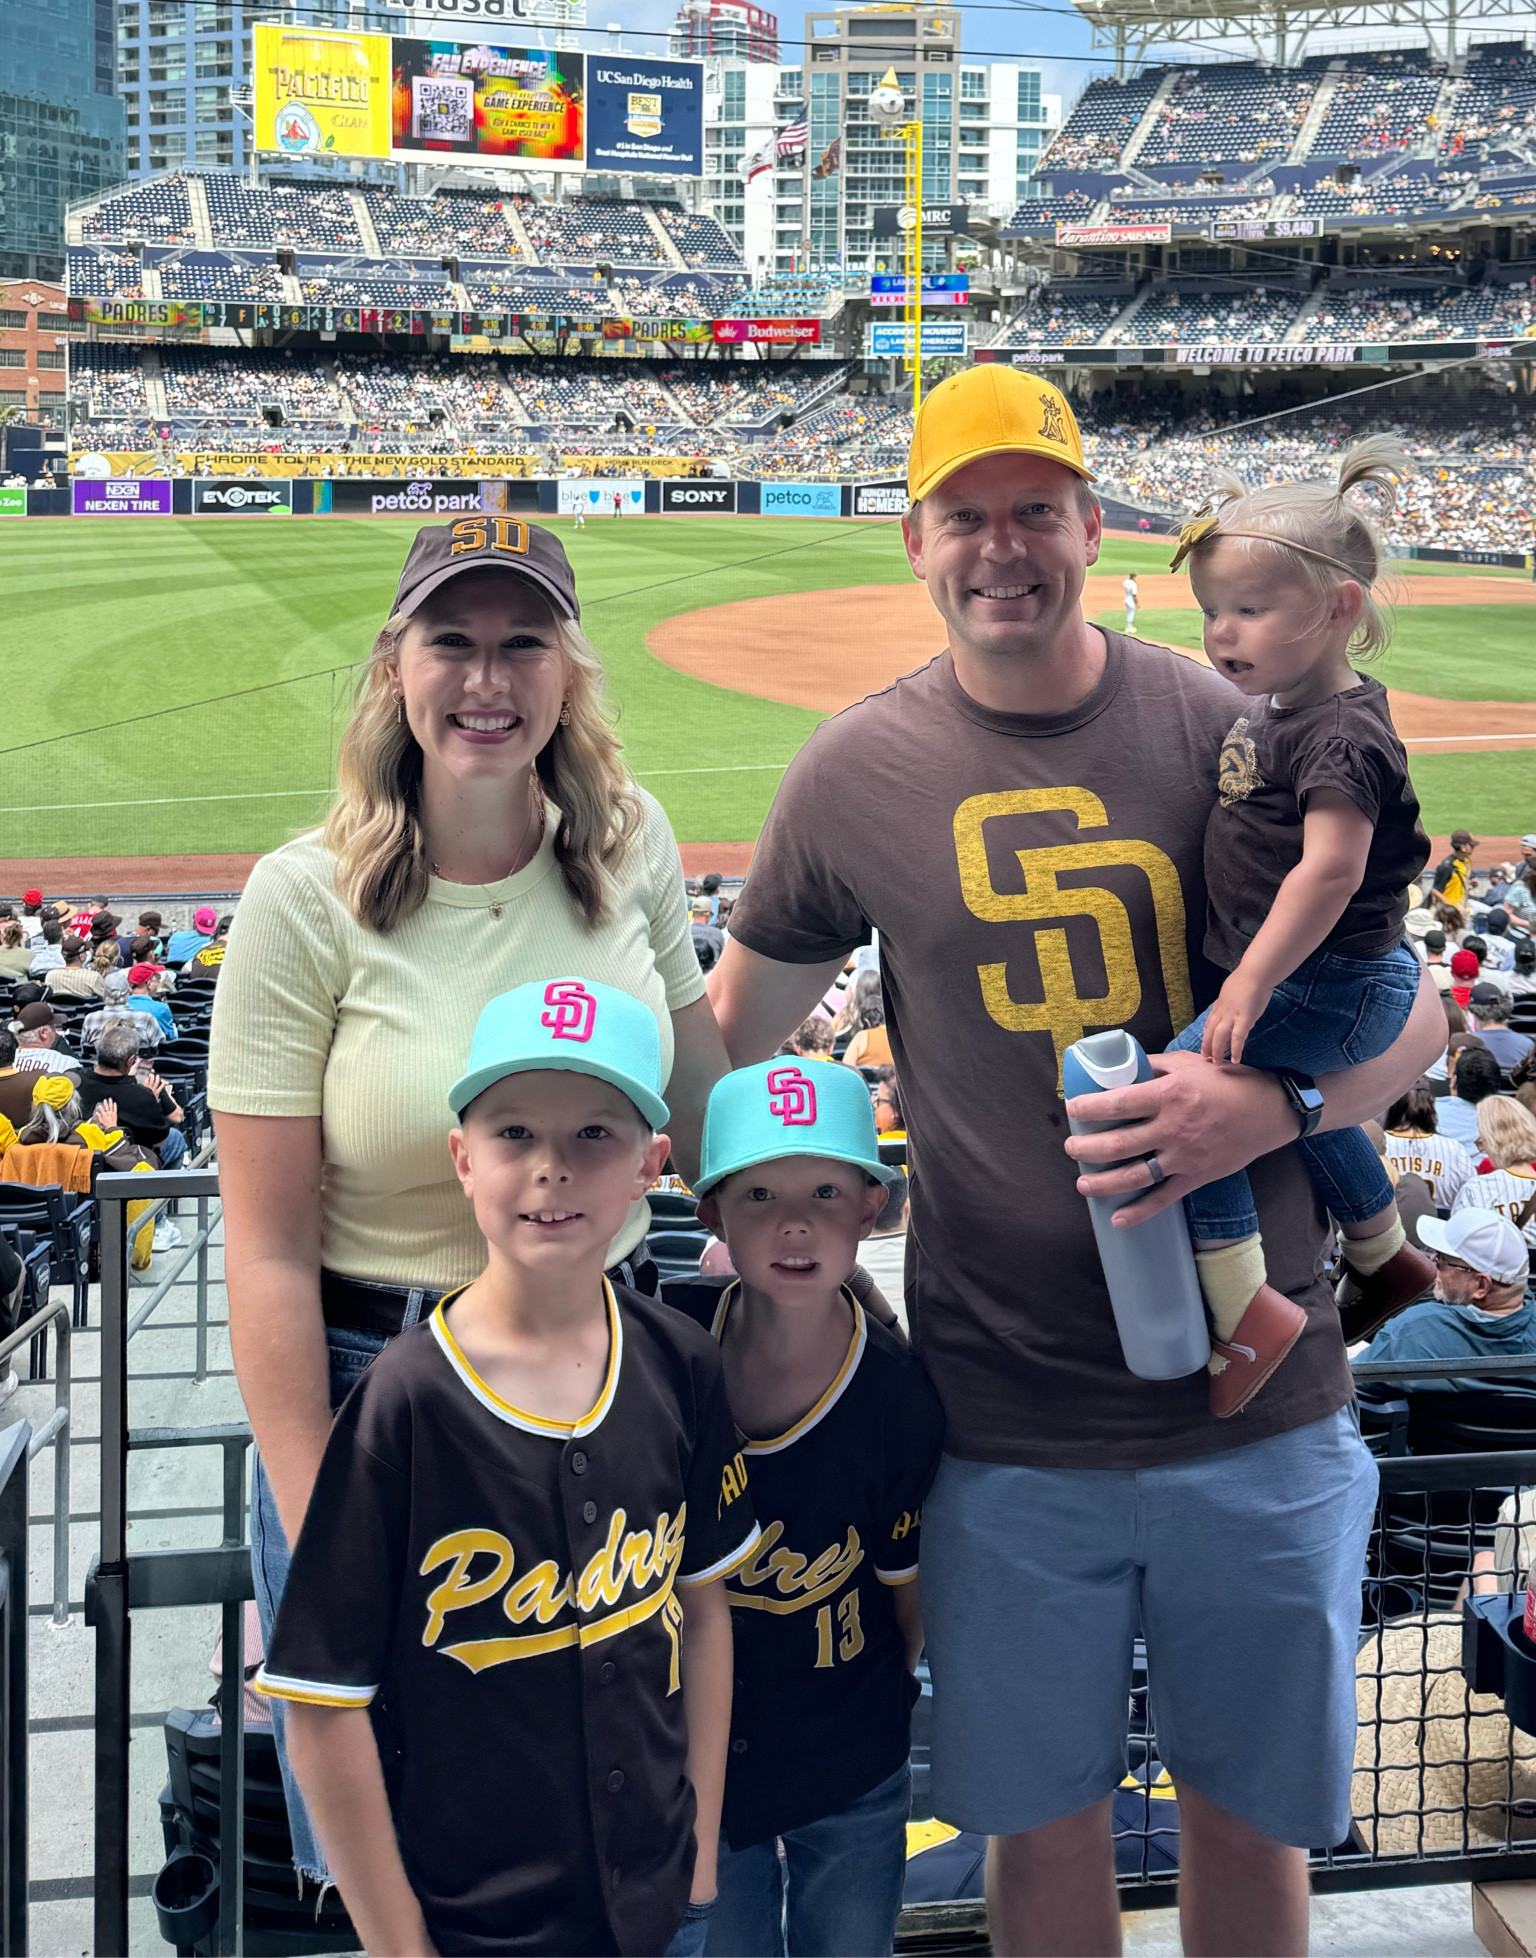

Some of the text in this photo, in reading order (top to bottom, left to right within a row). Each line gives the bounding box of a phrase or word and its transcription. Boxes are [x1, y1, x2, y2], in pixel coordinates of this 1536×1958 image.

[431, 53, 548, 79] FAN EXPERIENCE
[597, 70, 694, 90] UC San Diego Health
[484, 96, 566, 114] GAME EXPERIENCE
[631, 95, 658, 107] BEST
[922, 209, 951, 222] MRC
[1060, 229, 1168, 244] Tarantino SAUSAGES
[102, 302, 169, 322] PADRES
[239, 309, 247, 323] F
[291, 311, 300, 324] 6
[273, 317, 281, 330] 3
[325, 319, 333, 331] 0
[394, 315, 402, 328] 2
[632, 320, 687, 339] PADRES
[747, 324, 816, 338] Budweiser
[1012, 352, 1065, 364] petco park
[1176, 346, 1357, 363] WELCOME TO PETCO PARK
[195, 455, 525, 466] CHROME TOUR THE NEW GOLD STANDARD
[562, 490, 588, 501] blue
[604, 490, 630, 501] ble
[671, 490, 728, 503] SONY
[766, 490, 812, 507] petco
[860, 488, 907, 498] HUNGRY FOR
[3, 497, 22, 507] Zoo
[85, 500, 160, 511] NEXEN TIRE
[371, 492, 481, 513] petco park
[857, 497, 910, 513] HOMERS
[451, 517, 530, 557] SD
[952, 785, 1197, 1099] SD
[540, 980, 597, 1043] SD
[766, 1066, 818, 1127] SD
[724, 1520, 866, 1595] dres
[419, 1500, 687, 1648] Padres
[813, 1587, 866, 1669] 13
